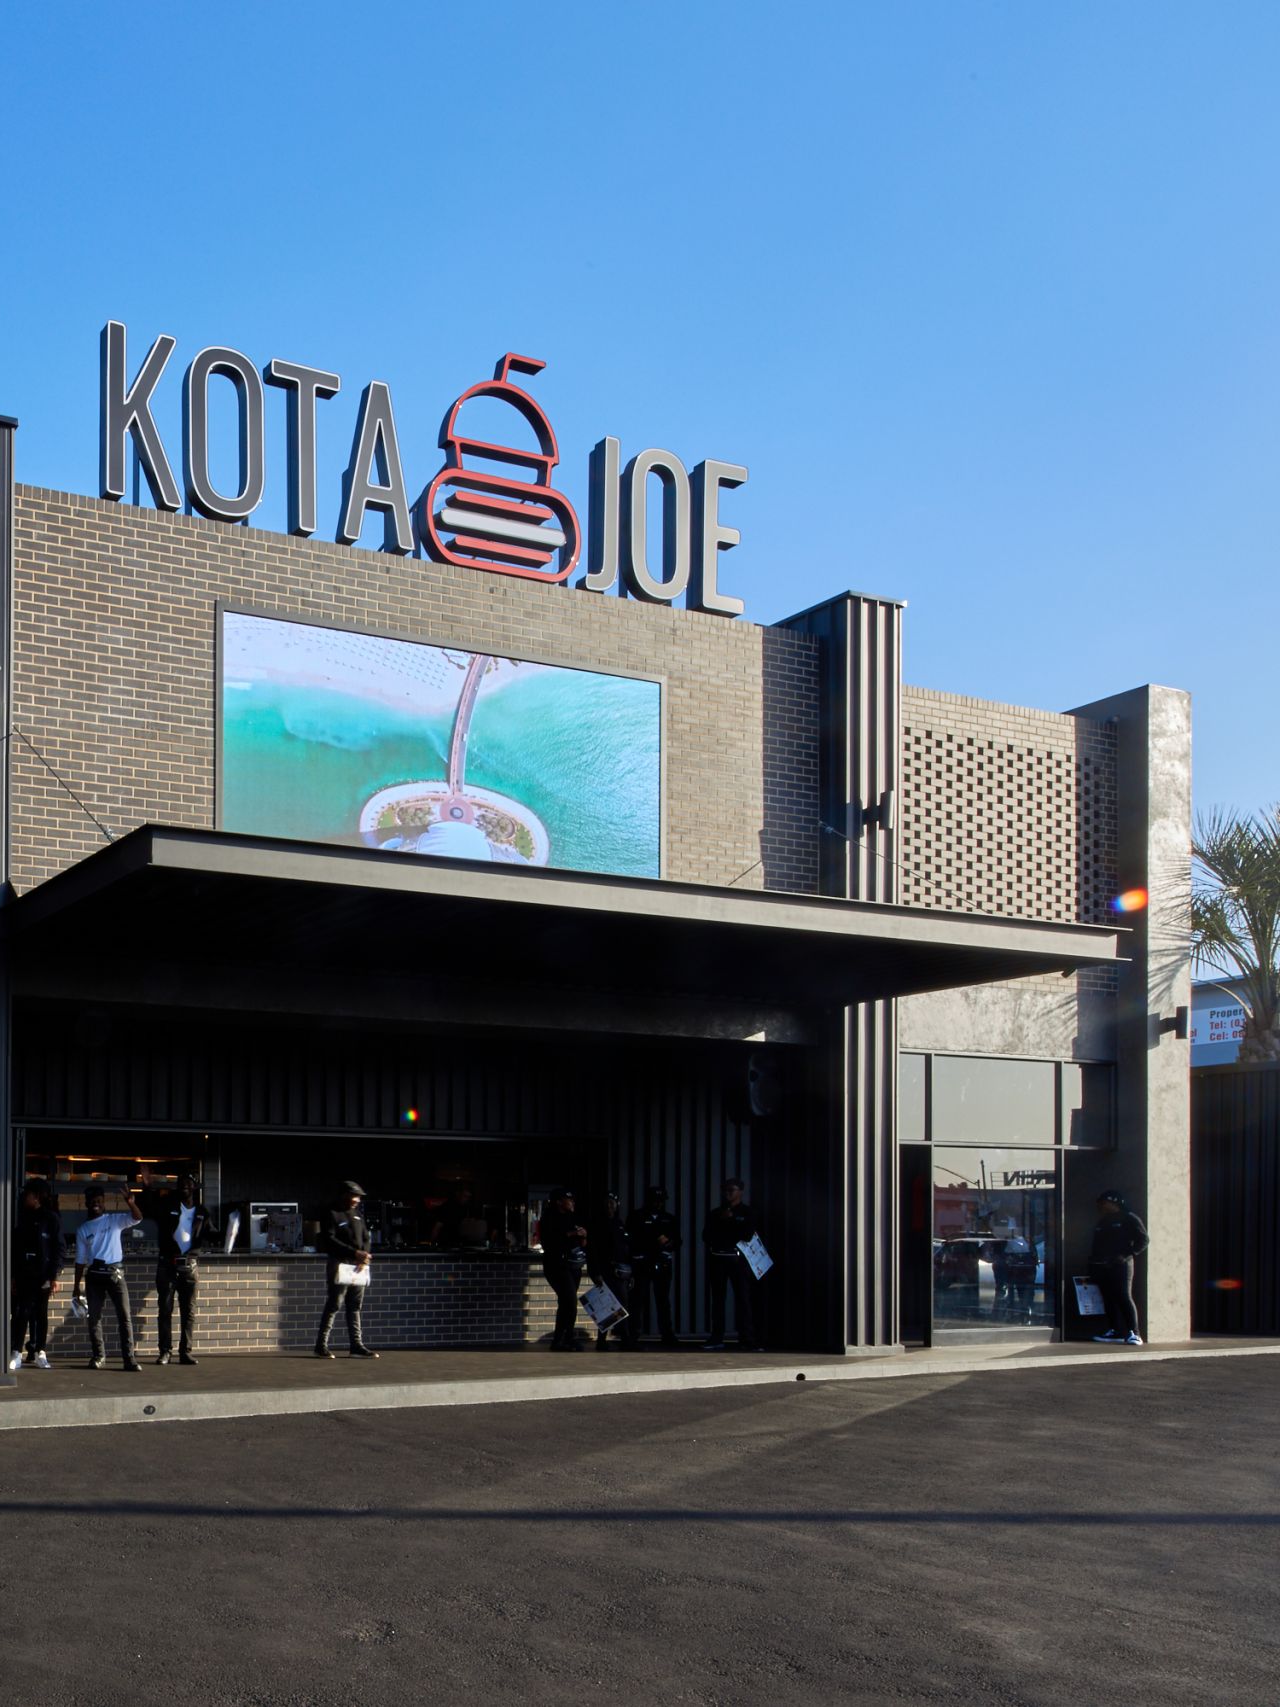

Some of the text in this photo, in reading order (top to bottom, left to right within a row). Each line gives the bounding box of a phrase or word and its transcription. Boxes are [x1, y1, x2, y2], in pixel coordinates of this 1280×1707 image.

[100, 320, 748, 618] KOTA JOE
[1209, 1007, 1243, 1019] Proper
[1209, 1020, 1227, 1030] Tel:
[1209, 1031, 1229, 1041] Cel:
